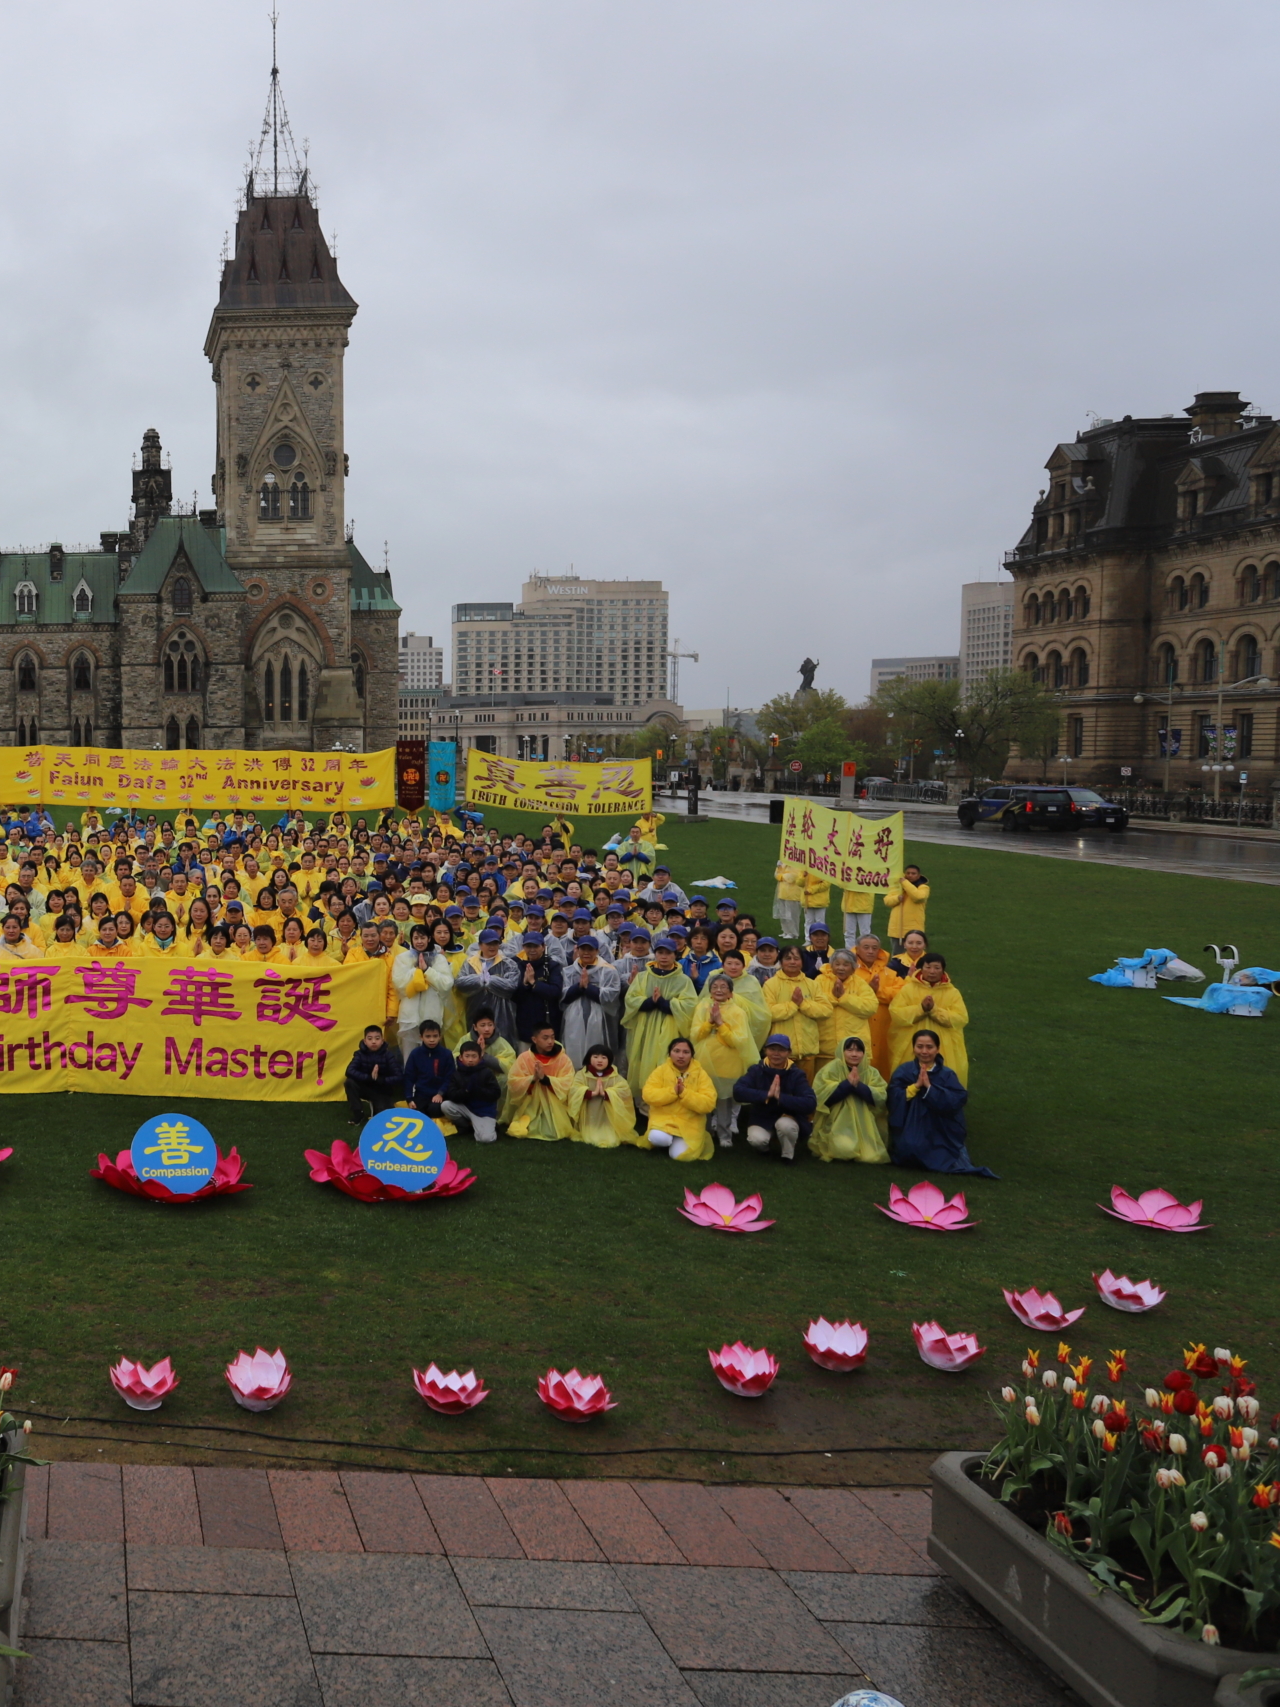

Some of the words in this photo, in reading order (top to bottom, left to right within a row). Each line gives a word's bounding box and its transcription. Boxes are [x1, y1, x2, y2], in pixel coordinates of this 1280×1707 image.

[547, 585, 588, 595] WESTIN
[49, 770, 103, 787] Falun
[118, 773, 166, 790] Dafa
[222, 775, 345, 796] Anniversary
[471, 789, 508, 806] TRUTH
[513, 798, 579, 814] COMPASSION
[587, 800, 646, 814] TOLERANCE
[784, 838, 806, 865] Falun
[808, 847, 837, 878] Dafa
[841, 861, 853, 883] is
[855, 866, 890, 888] Good
[165, 1036, 327, 1086] Master!
[144, 1121, 204, 1165] 善
[372, 1116, 433, 1162] 忍
[142, 1166, 209, 1178] Compassion
[367, 1159, 438, 1174] Forbearance
